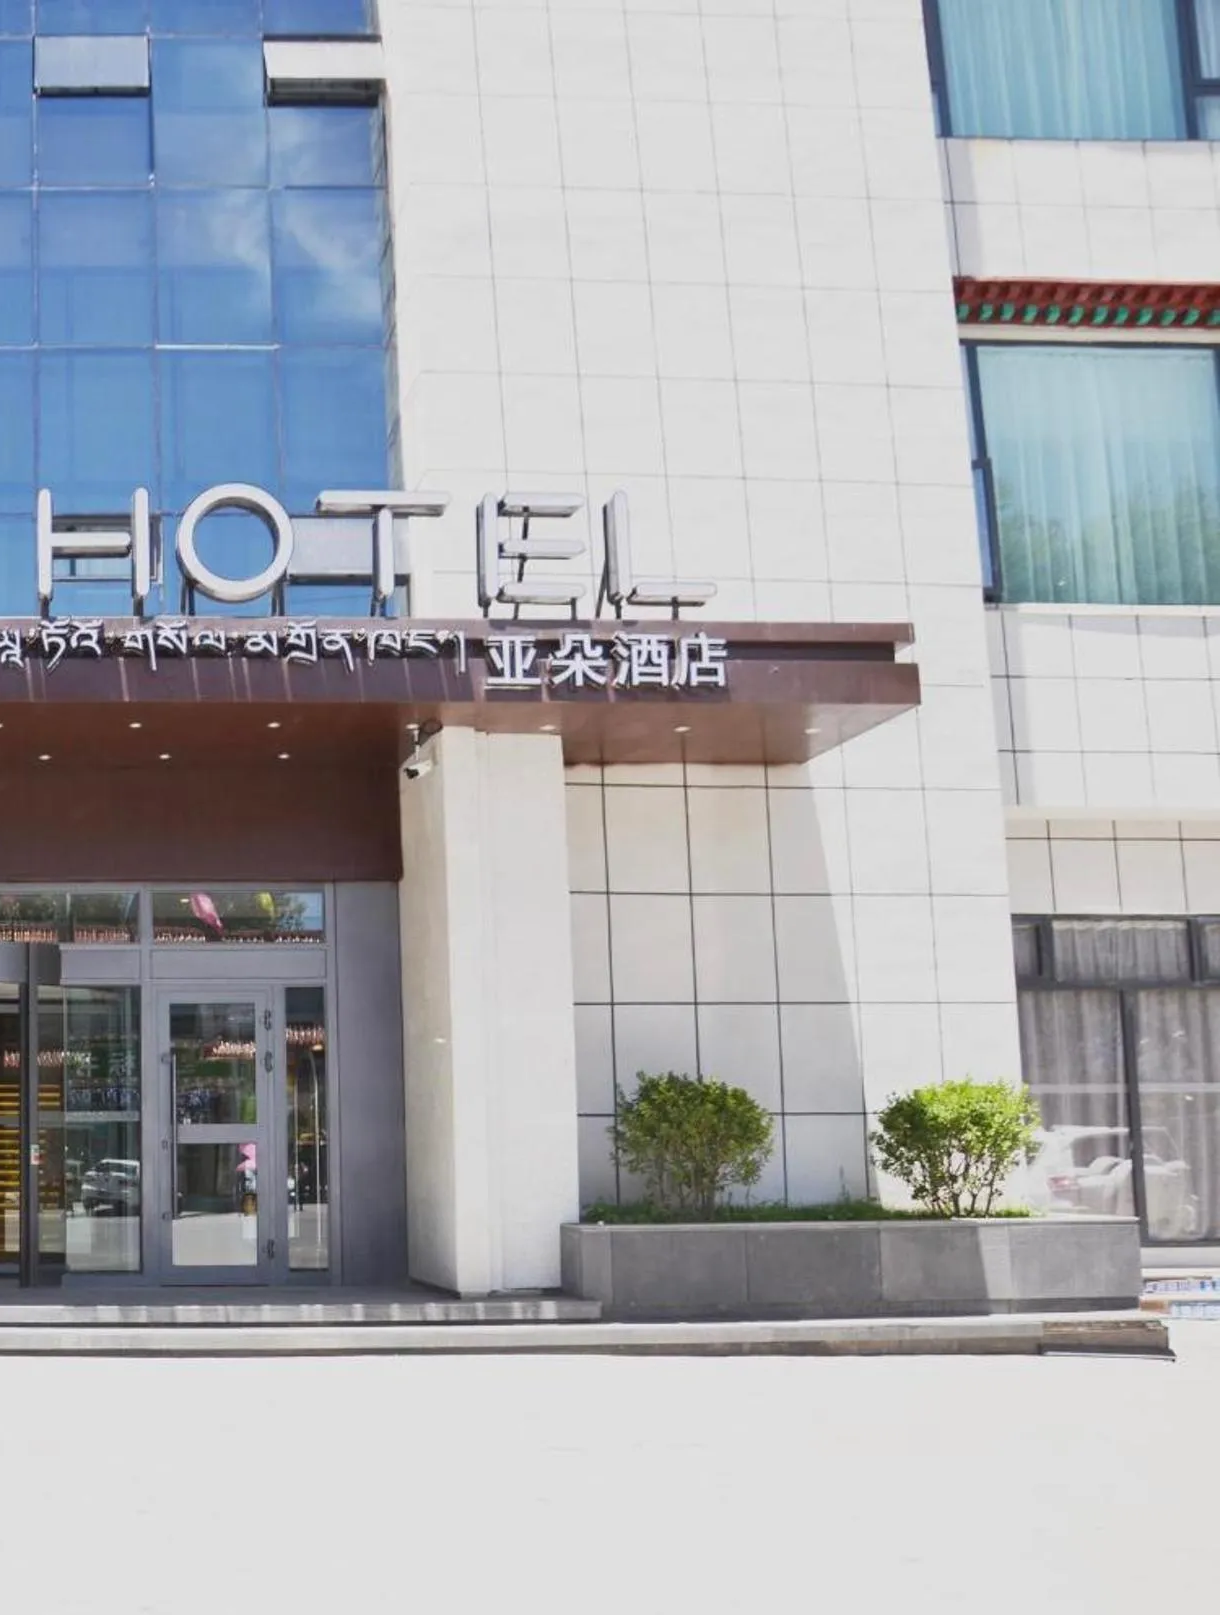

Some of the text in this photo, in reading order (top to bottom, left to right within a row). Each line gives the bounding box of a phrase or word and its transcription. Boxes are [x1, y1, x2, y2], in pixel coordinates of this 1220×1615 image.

[37, 483, 718, 606] HOTEL
[484, 632, 728, 689] 亚朵酒店
